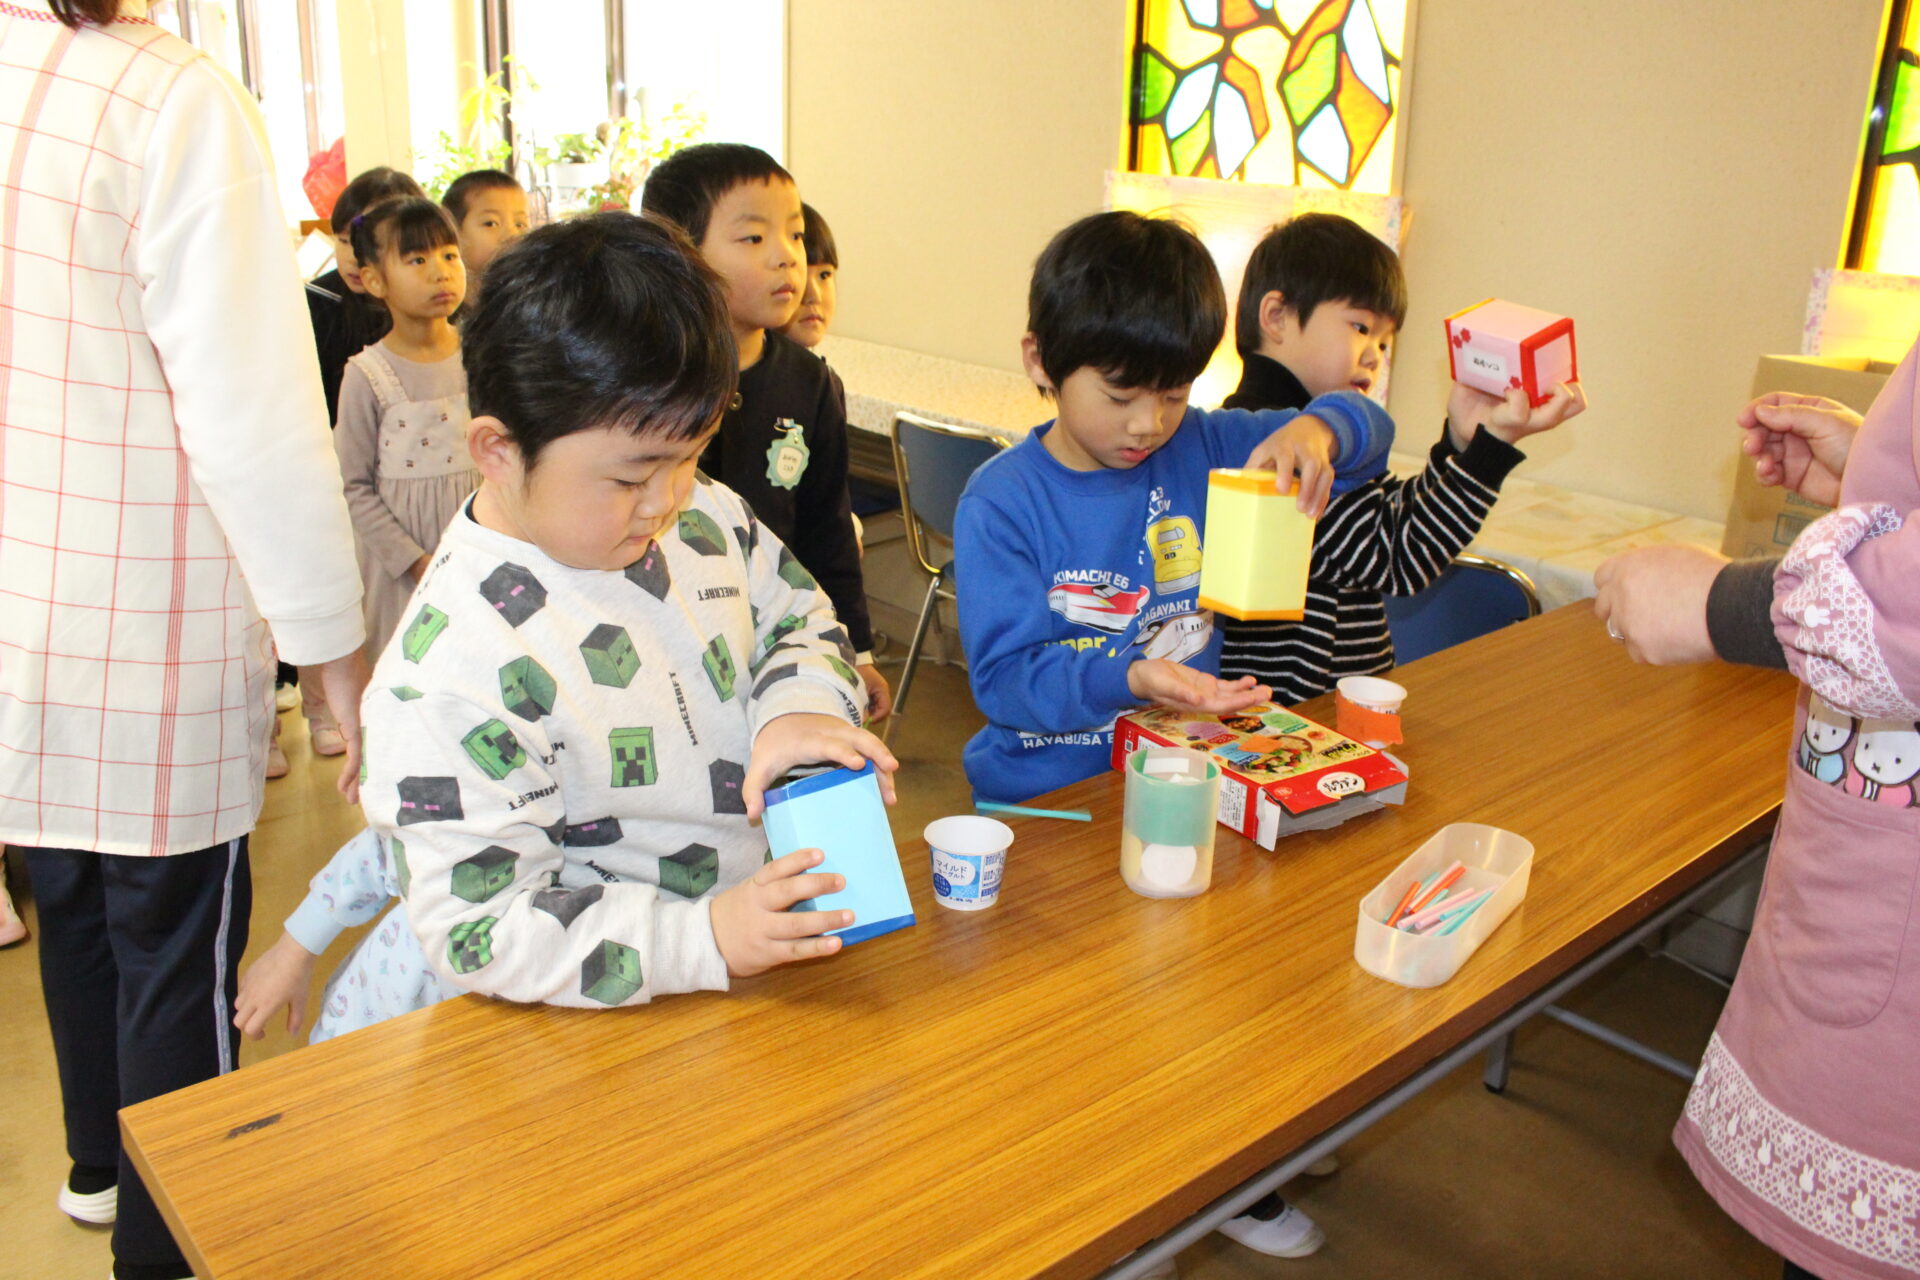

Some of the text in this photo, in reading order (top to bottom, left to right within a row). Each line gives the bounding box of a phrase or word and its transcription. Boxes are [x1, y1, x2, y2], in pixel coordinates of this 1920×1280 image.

[1113, 573, 1130, 590] E6
[1137, 599, 1191, 631] KAGAYAKI
[668, 671, 699, 746] MINECRAFT
[1023, 733, 1102, 749] HAYABUSA
